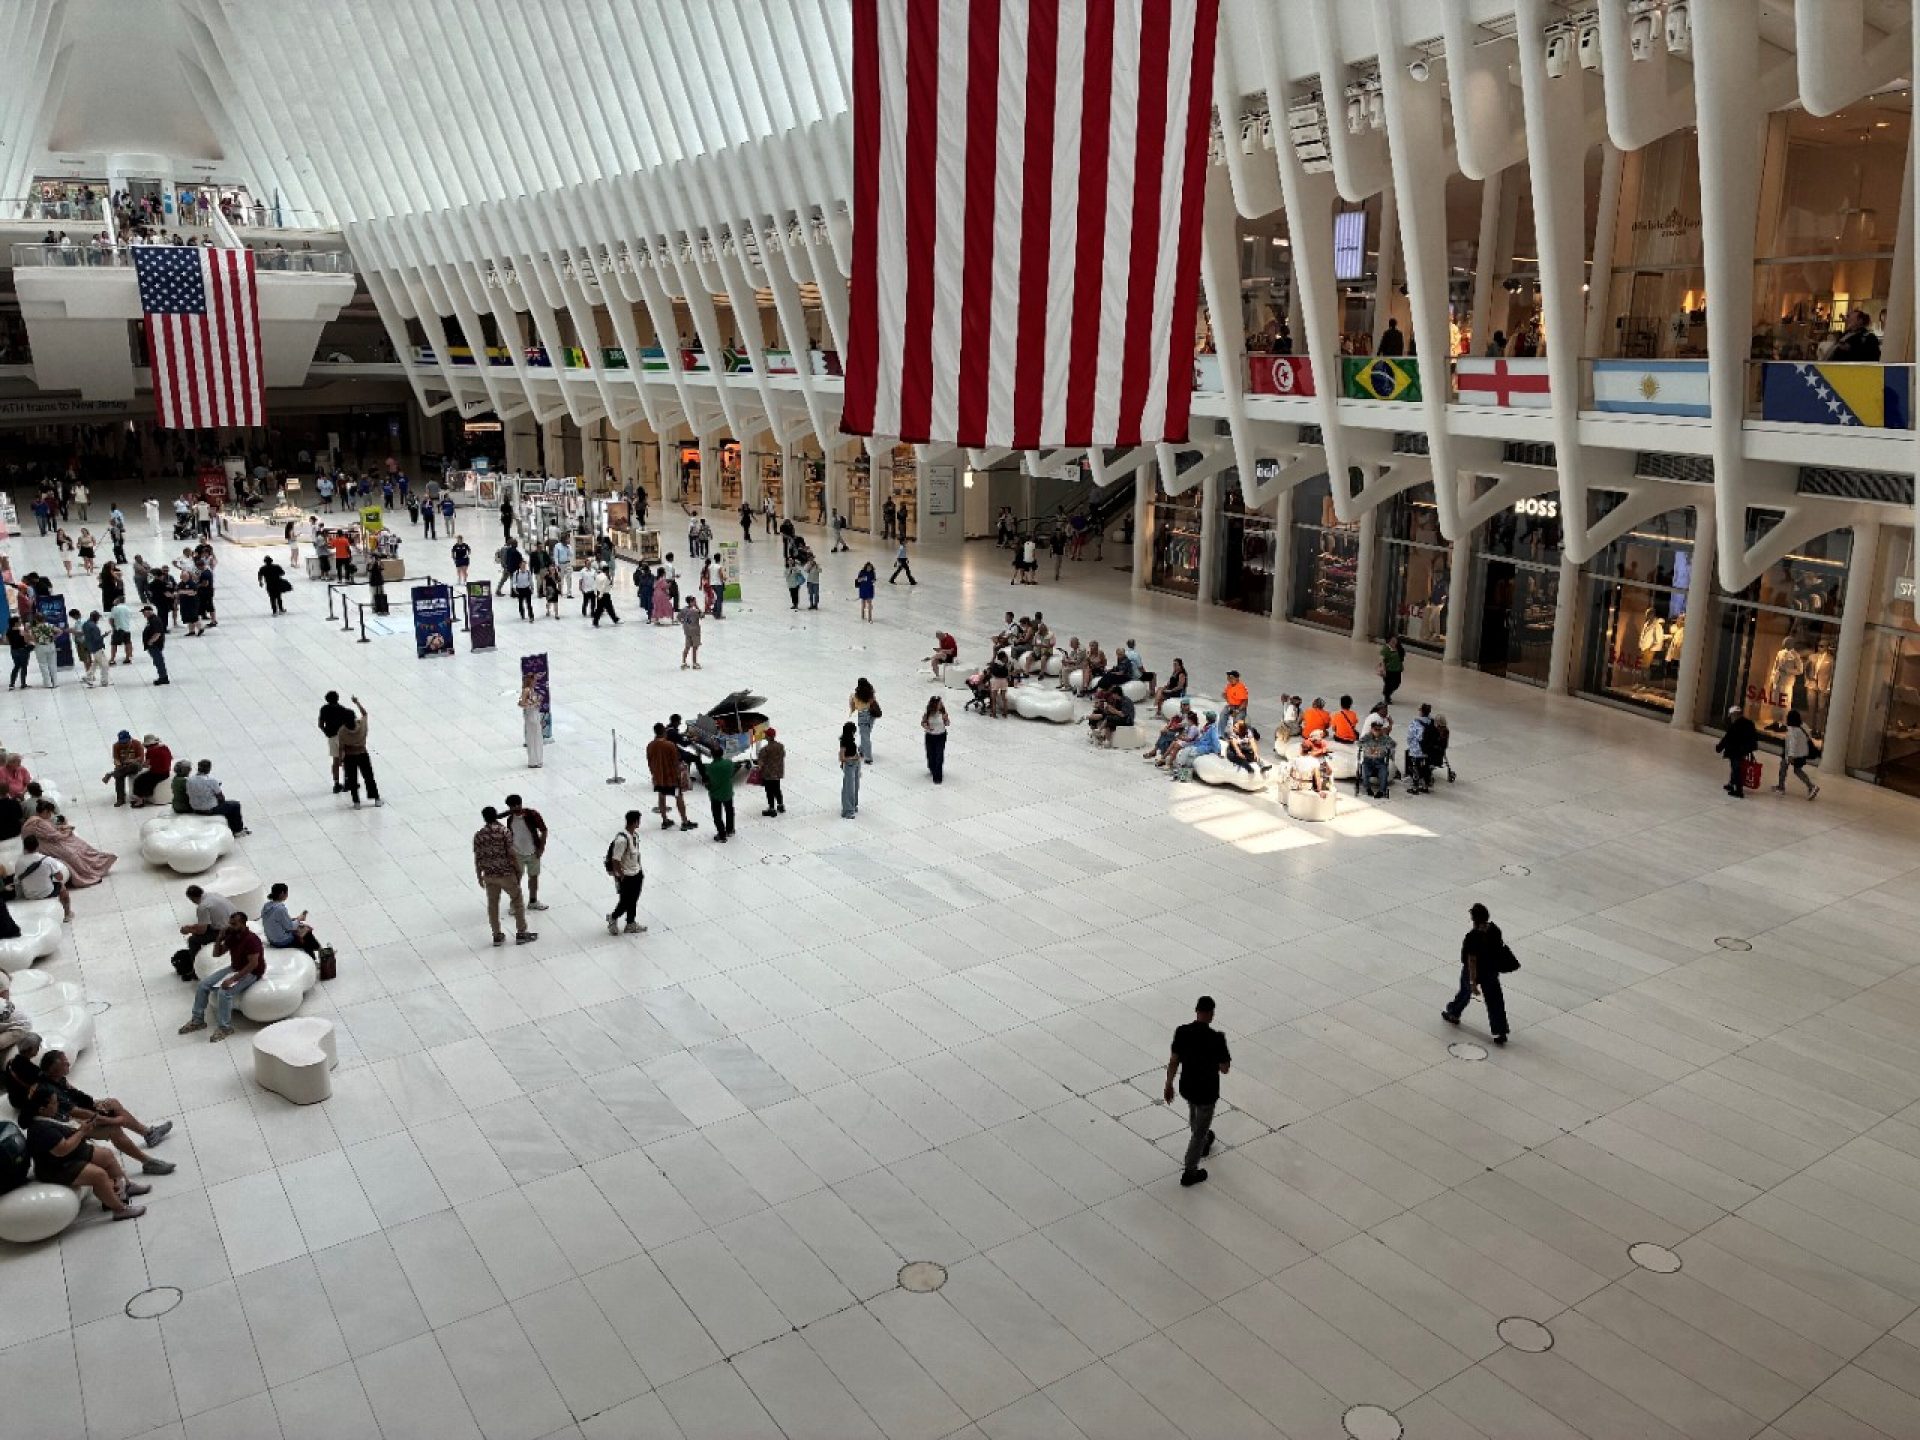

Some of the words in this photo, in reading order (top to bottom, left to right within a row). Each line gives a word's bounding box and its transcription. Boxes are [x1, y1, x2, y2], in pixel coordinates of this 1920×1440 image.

[0, 402, 24, 413] ATH
[59, 401, 70, 411] to
[72, 400, 94, 411] New
[1747, 684, 1789, 708] SALE
